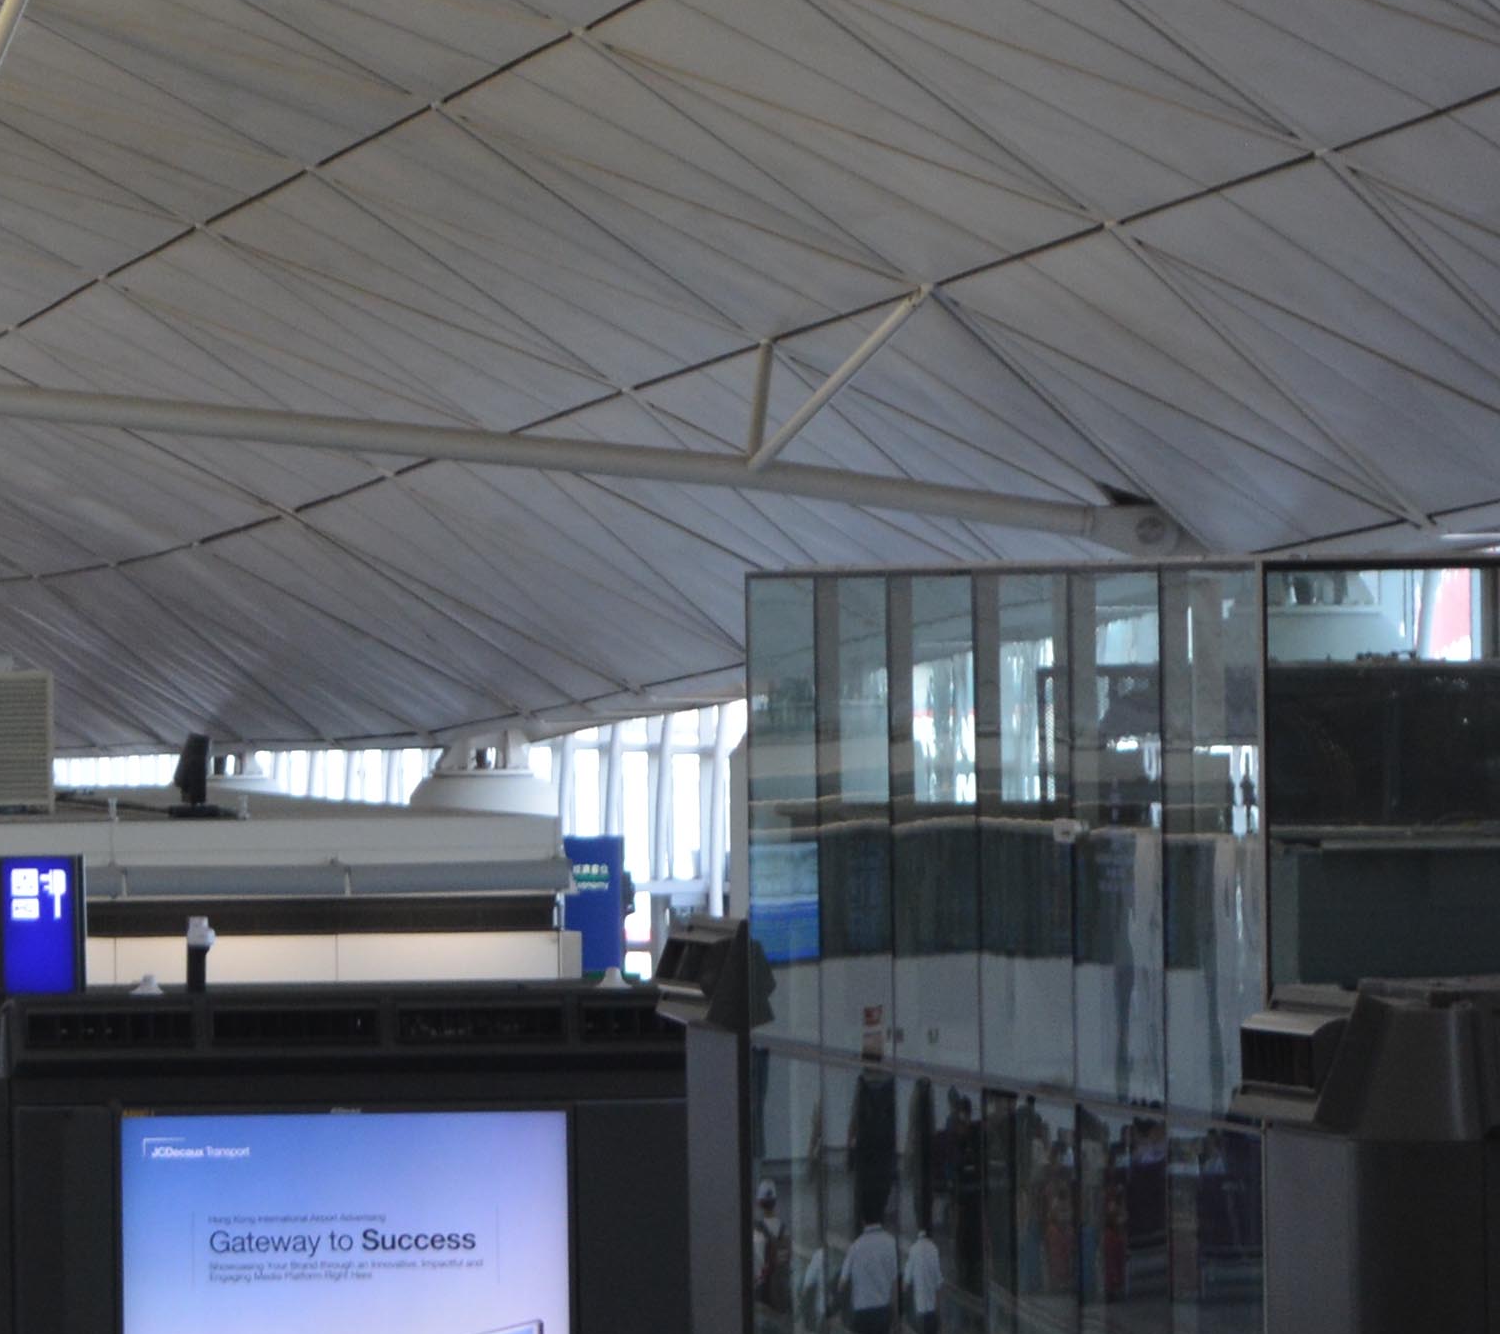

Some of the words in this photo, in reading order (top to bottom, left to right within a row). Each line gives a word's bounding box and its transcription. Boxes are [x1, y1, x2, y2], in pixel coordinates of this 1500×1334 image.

[209, 1229, 321, 1258] Gateway
[329, 1229, 353, 1251] to
[362, 1228, 476, 1251] Success
